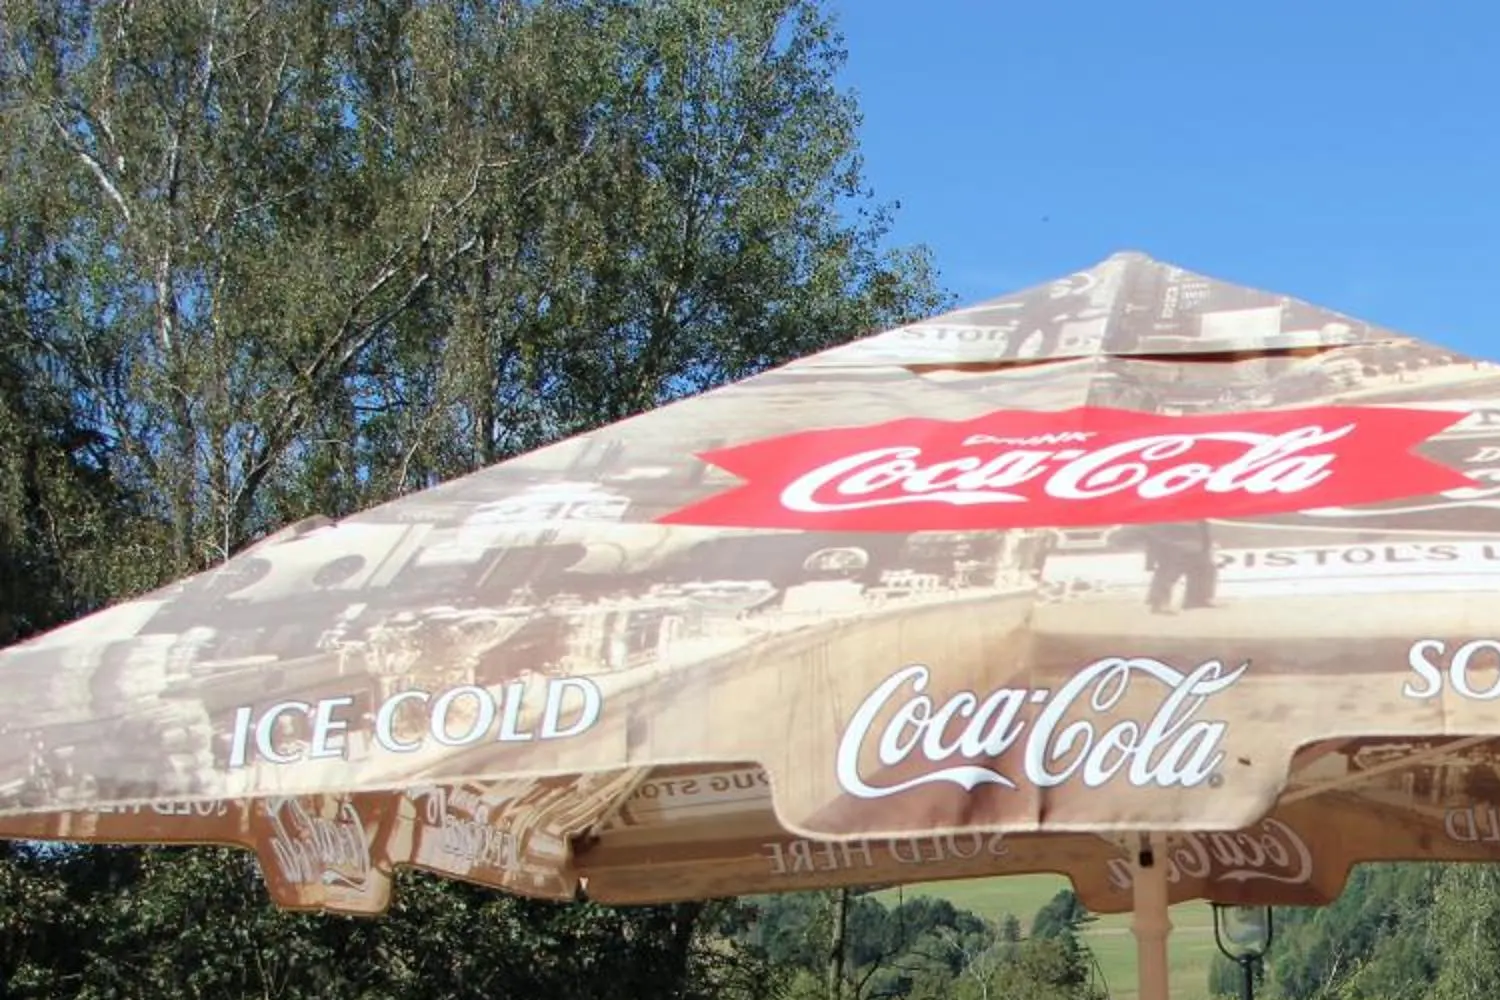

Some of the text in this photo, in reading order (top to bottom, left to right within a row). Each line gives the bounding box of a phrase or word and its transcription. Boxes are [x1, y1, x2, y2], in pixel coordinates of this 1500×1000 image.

[780, 424, 1355, 512] Coca-Cola
[228, 675, 603, 768] ICE COLD
[836, 657, 1250, 799] Coca-Cola
